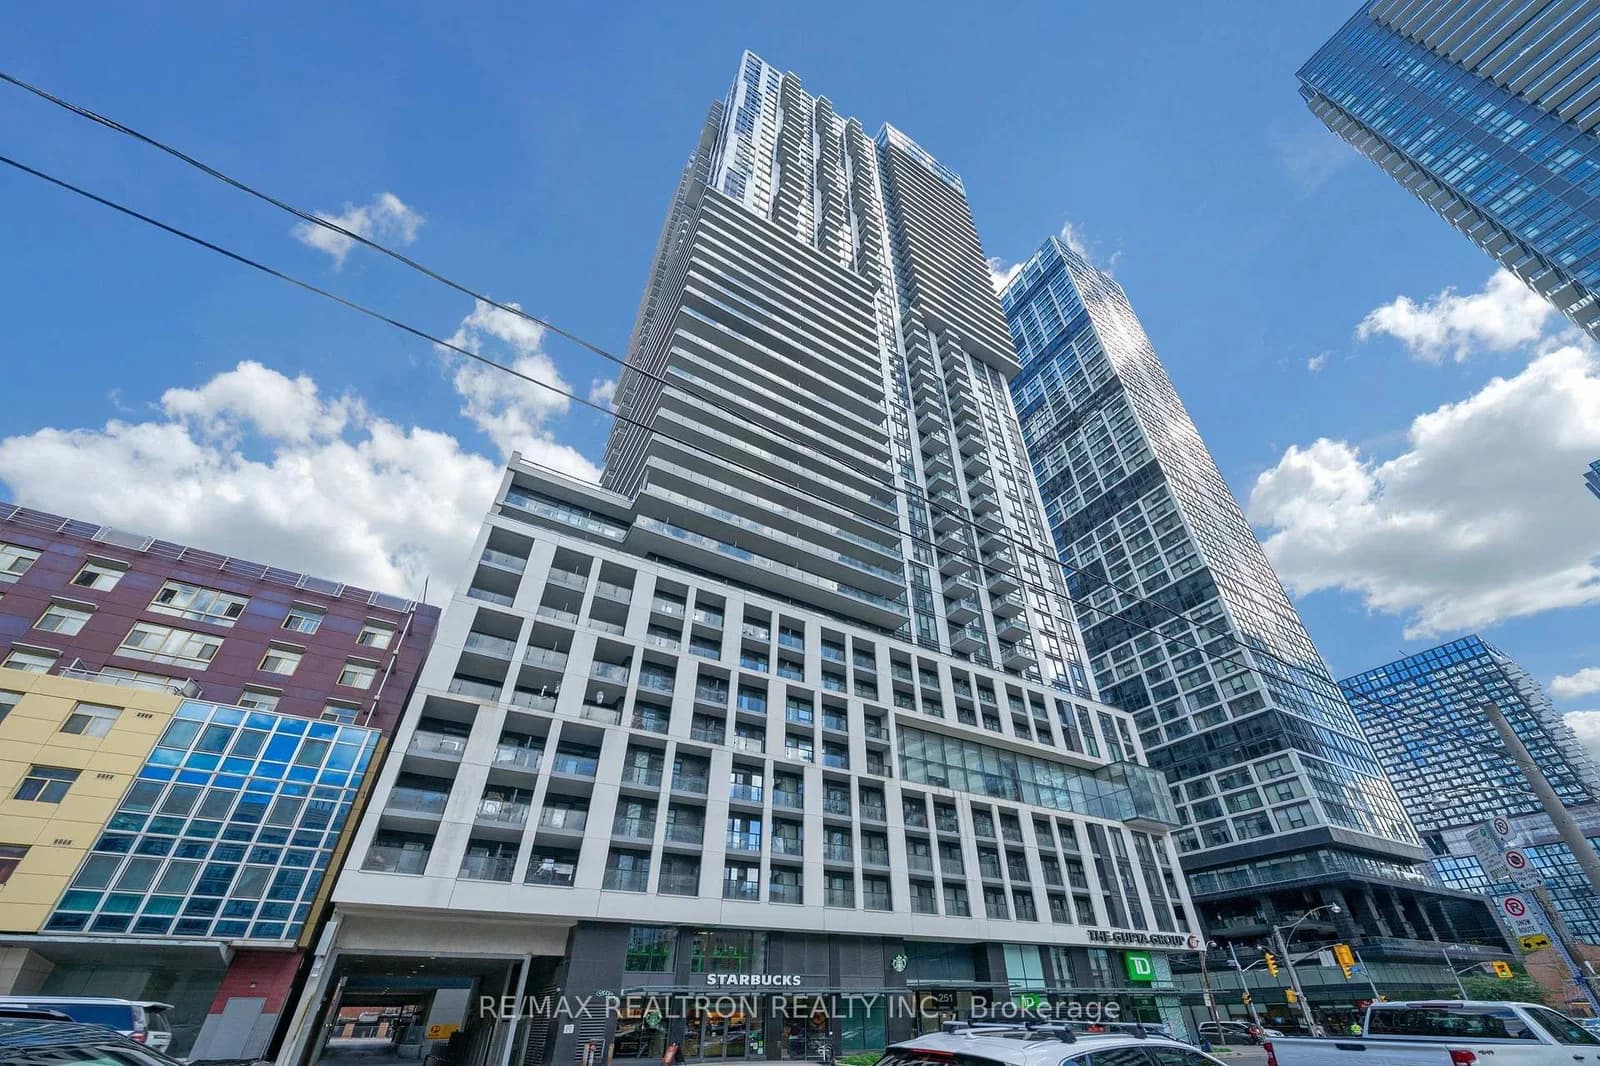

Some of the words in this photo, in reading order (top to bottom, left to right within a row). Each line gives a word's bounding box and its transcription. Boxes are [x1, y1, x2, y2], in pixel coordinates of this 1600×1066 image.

[1087, 930, 1111, 942] THE
[1112, 932, 1148, 945] GUPTA
[1149, 934, 1185, 947] GROUP
[1130, 957, 1151, 975] TD
[707, 973, 802, 986] STARBUCKS
[938, 993, 953, 1003] 251
